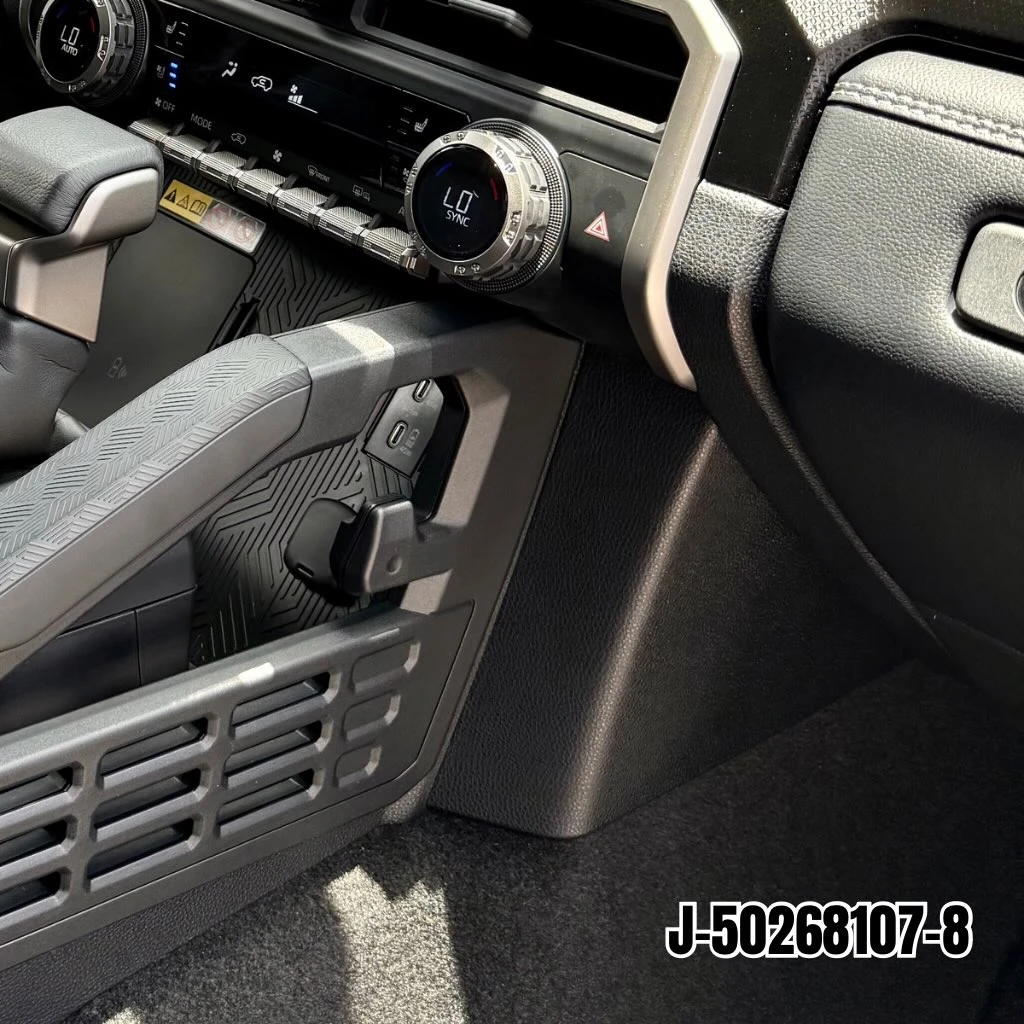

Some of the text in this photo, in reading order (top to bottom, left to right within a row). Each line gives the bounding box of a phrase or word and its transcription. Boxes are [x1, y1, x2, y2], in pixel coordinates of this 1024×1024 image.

[60, 24, 80, 46] LO
[61, 44, 78, 57] AUTO
[162, 100, 176, 113] OFF
[190, 113, 213, 131] MODE
[443, 186, 474, 215] LO
[445, 209, 471, 228] SYNC
